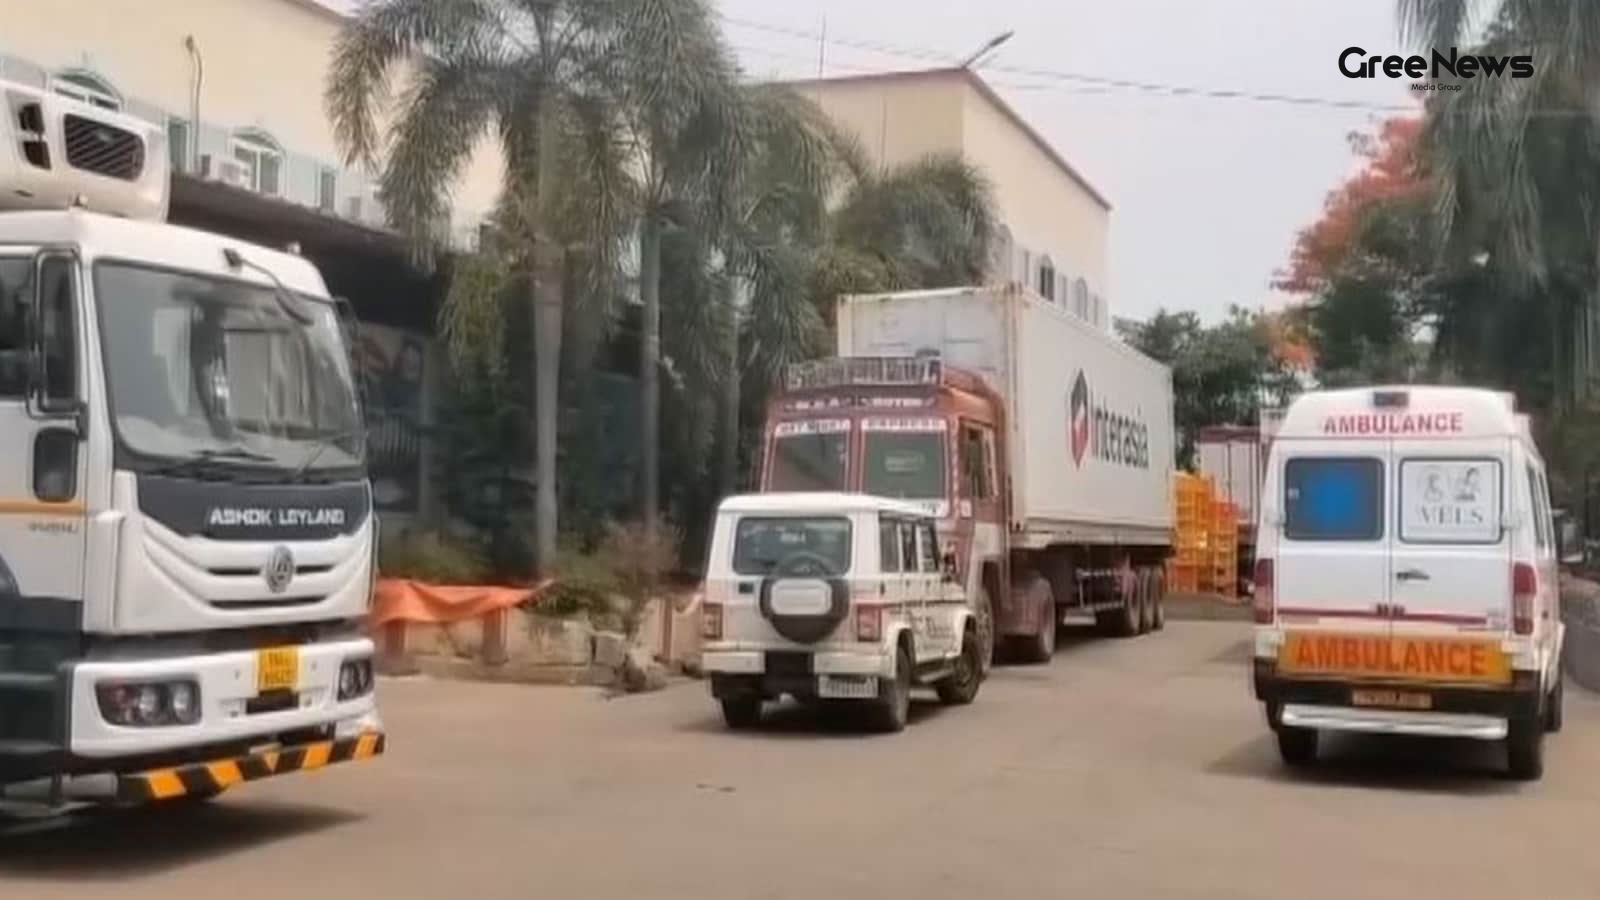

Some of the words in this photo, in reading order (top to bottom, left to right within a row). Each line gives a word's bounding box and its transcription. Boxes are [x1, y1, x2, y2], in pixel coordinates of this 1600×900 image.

[1323, 411, 1464, 435] AMBULANCE
[210, 507, 273, 526] ASHOK
[279, 507, 345, 526] LEYLAND
[1297, 633, 1487, 677] AMBULANCE
